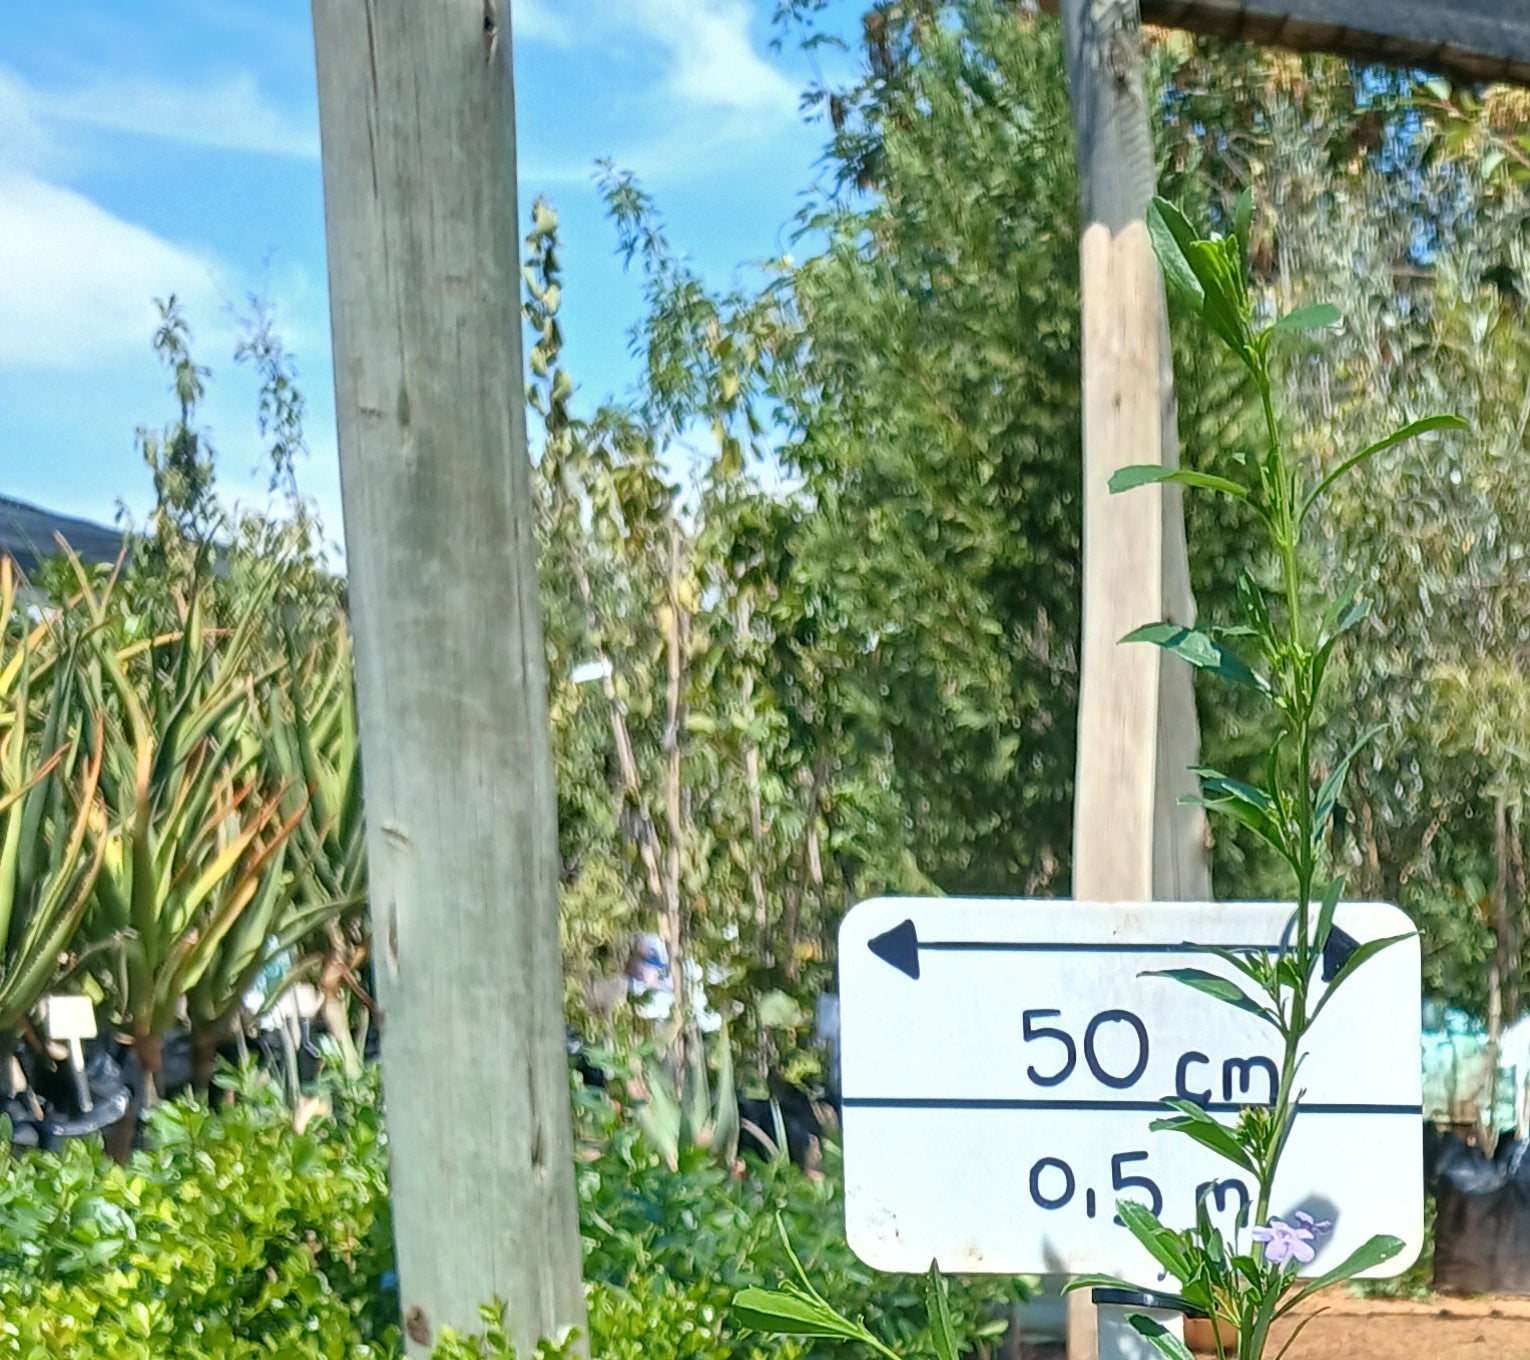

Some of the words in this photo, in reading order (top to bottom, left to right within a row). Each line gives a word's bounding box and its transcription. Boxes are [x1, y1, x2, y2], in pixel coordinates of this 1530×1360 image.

[1022, 1008, 1149, 1089] 50
[1175, 1051, 1280, 1106] cm
[1029, 1151, 1163, 1226] 0,5
[1195, 1177, 1251, 1228] m
